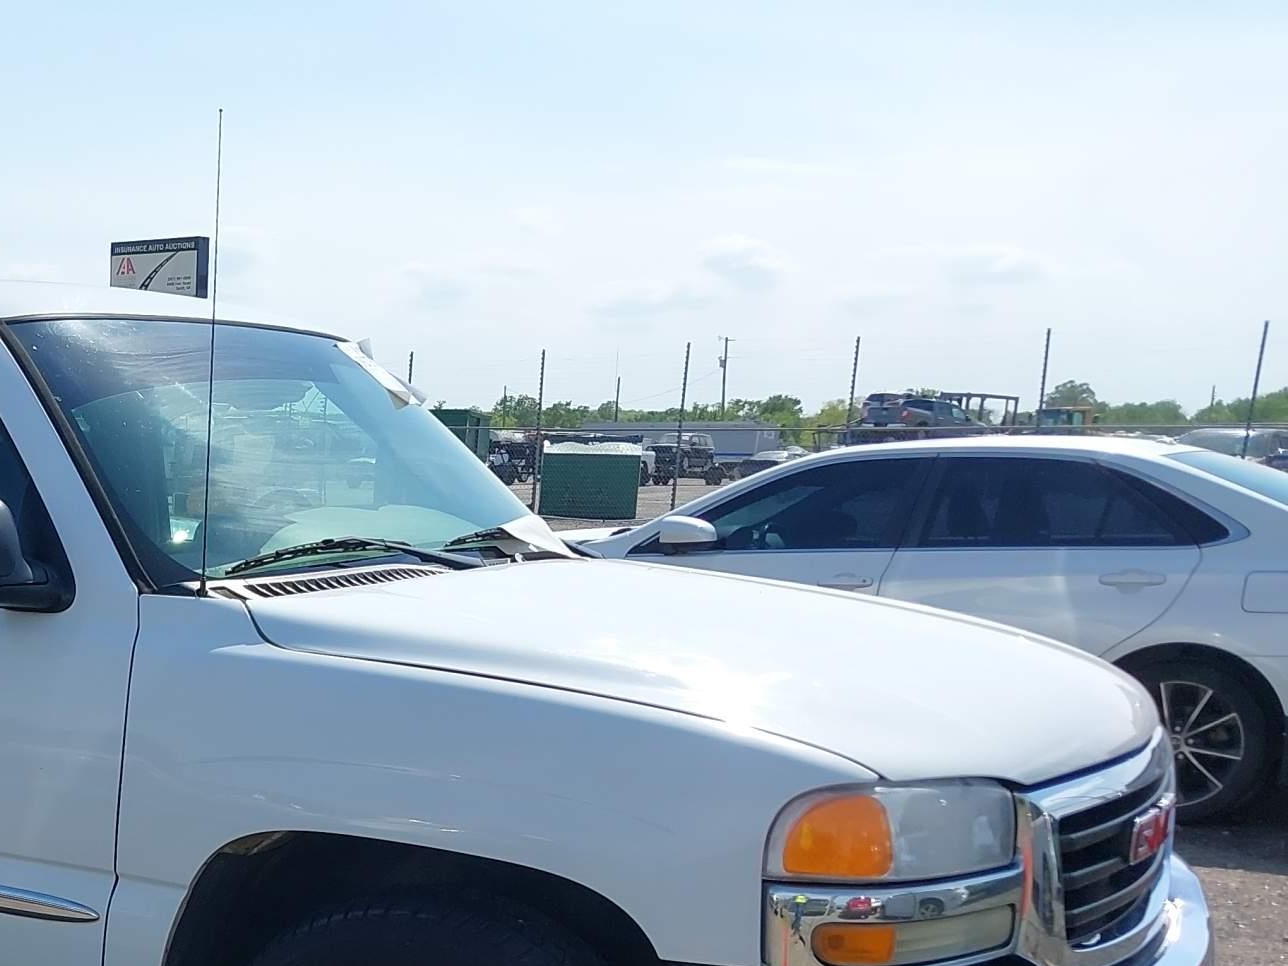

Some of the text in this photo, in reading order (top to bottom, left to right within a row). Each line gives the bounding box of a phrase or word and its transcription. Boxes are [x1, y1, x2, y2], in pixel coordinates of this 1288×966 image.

[114, 241, 195, 254] INSURANCE AUTO AUCTIONS
